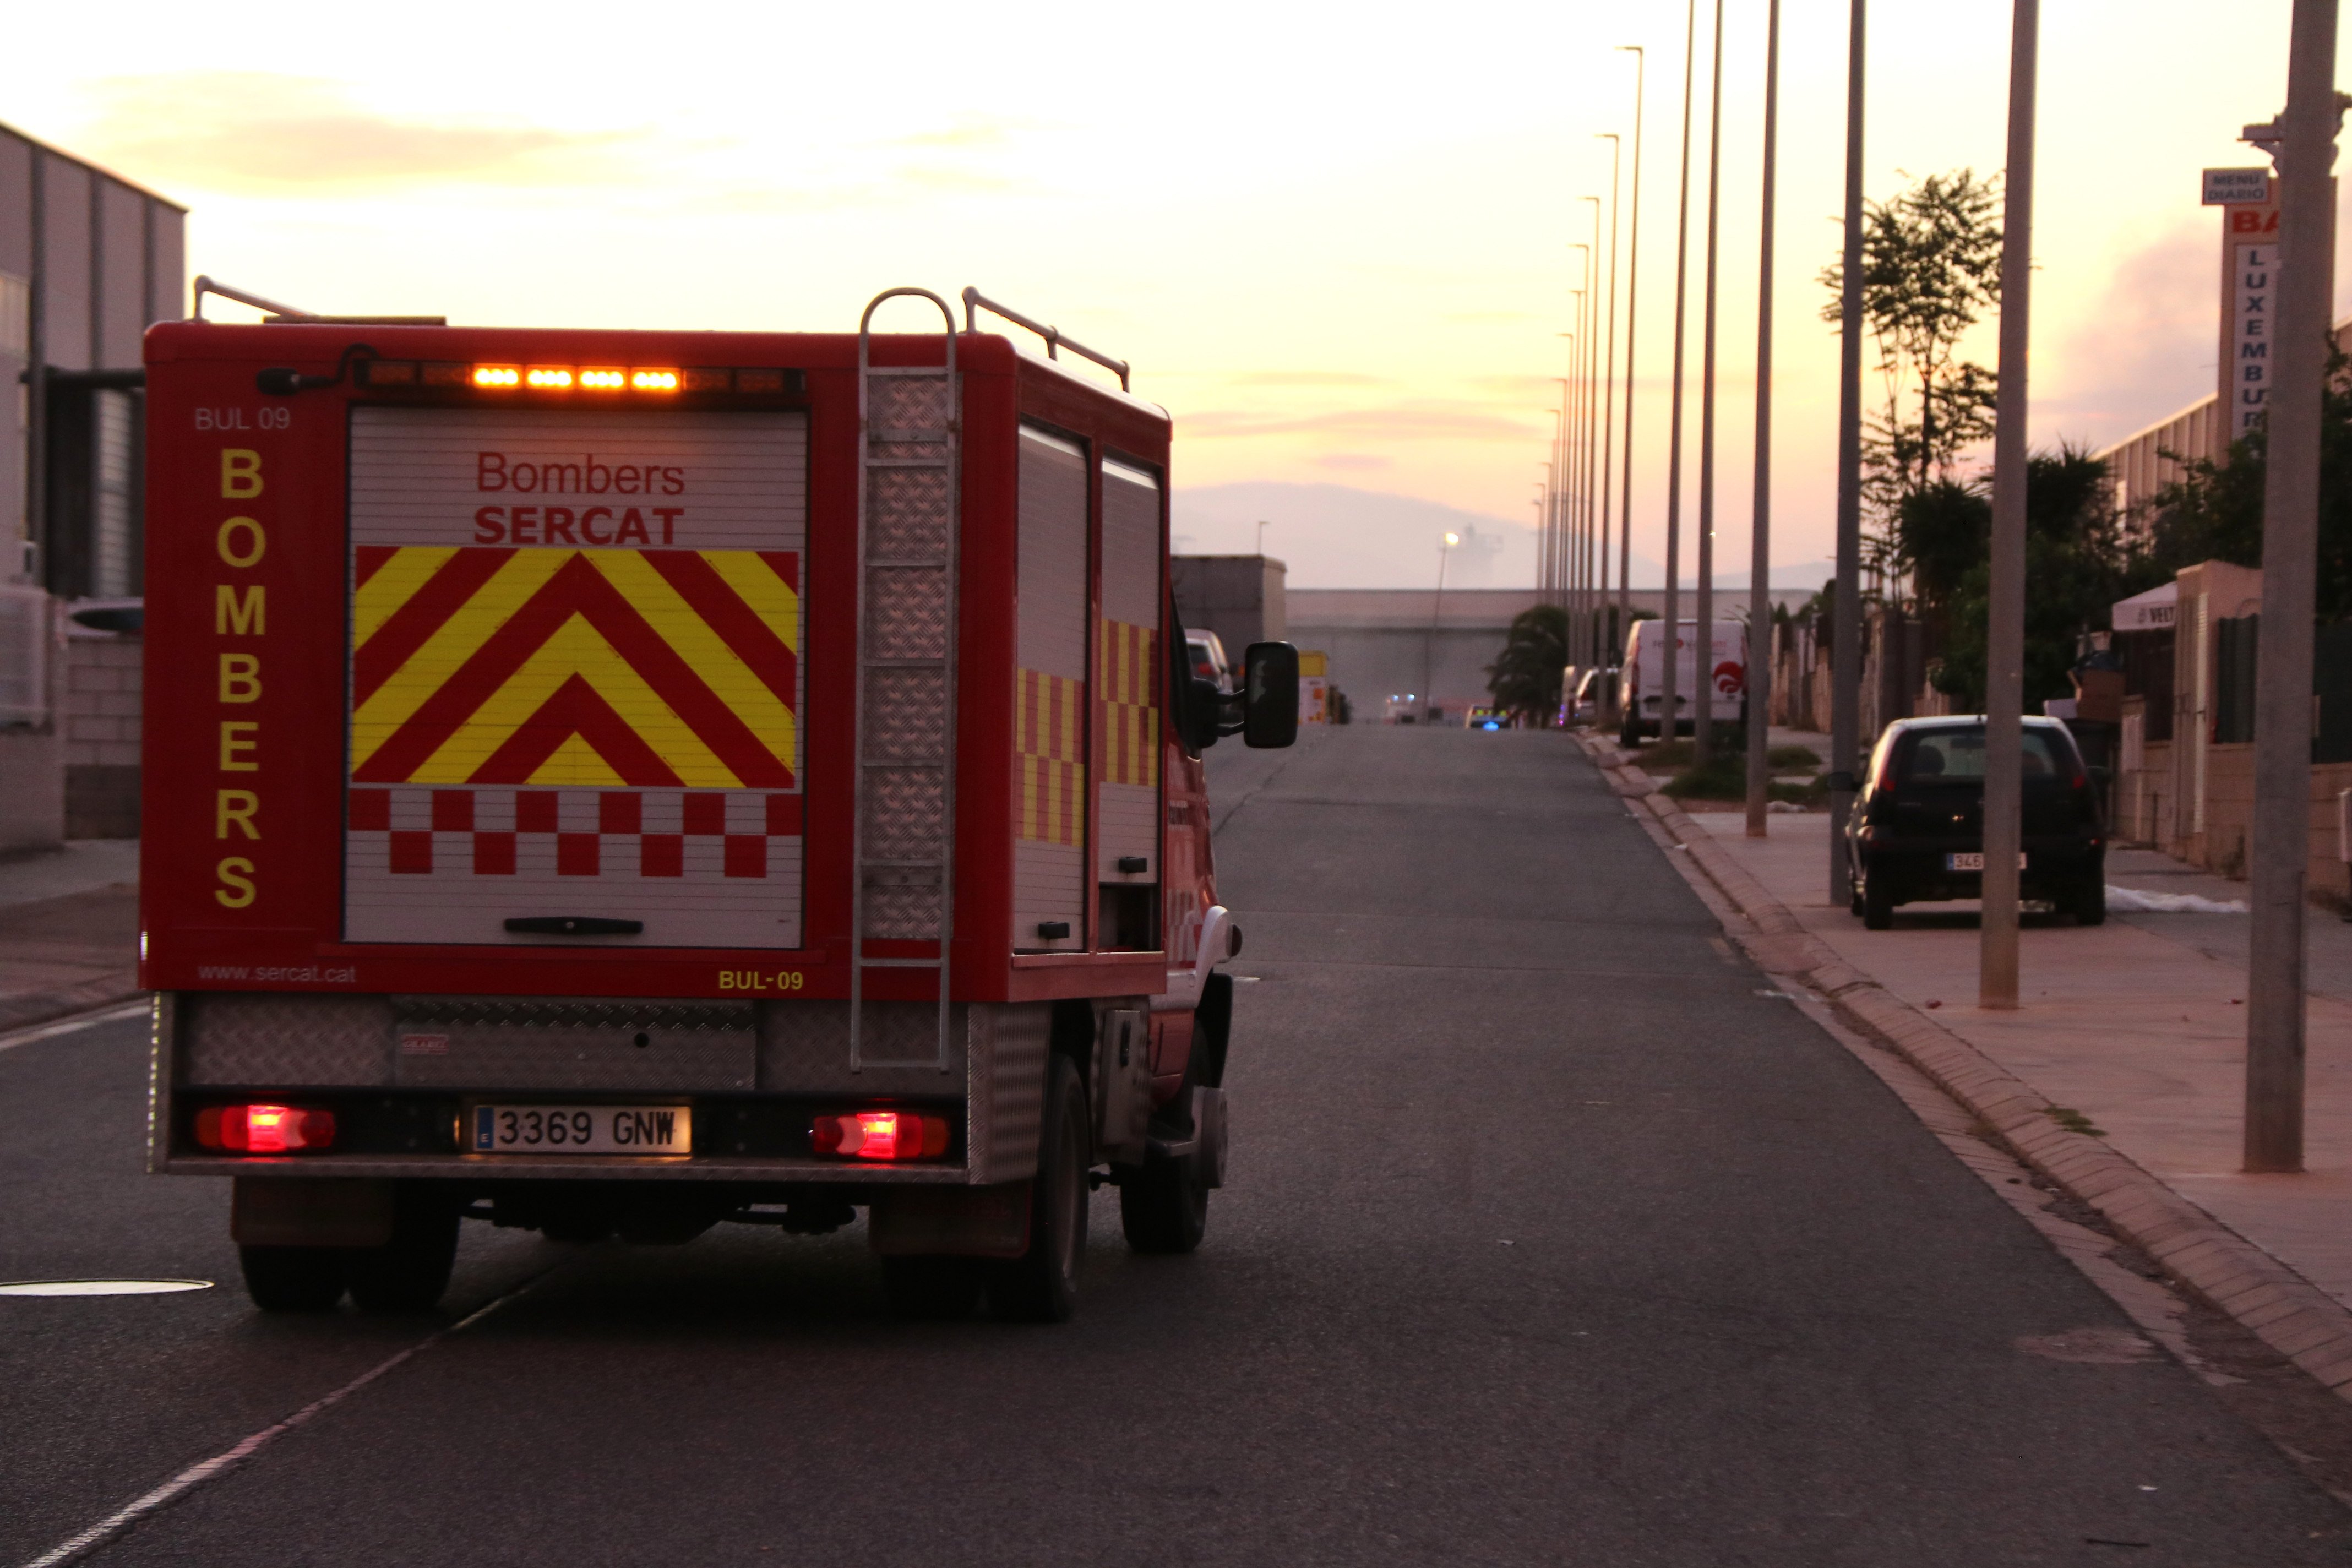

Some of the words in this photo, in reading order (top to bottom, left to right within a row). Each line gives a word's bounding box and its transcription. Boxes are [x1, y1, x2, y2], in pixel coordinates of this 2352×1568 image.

[2208, 188, 2264, 200] DIARIO
[195, 407, 250, 430] BUL
[258, 407, 290, 429] 09
[478, 451, 684, 495] Bombers
[474, 506, 684, 545] SERCAT
[215, 448, 266, 908] BOMBERS
[197, 966, 356, 982] www.sercat.cat
[499, 1111, 592, 1145] 3369
[613, 1112, 674, 1145] GNW
